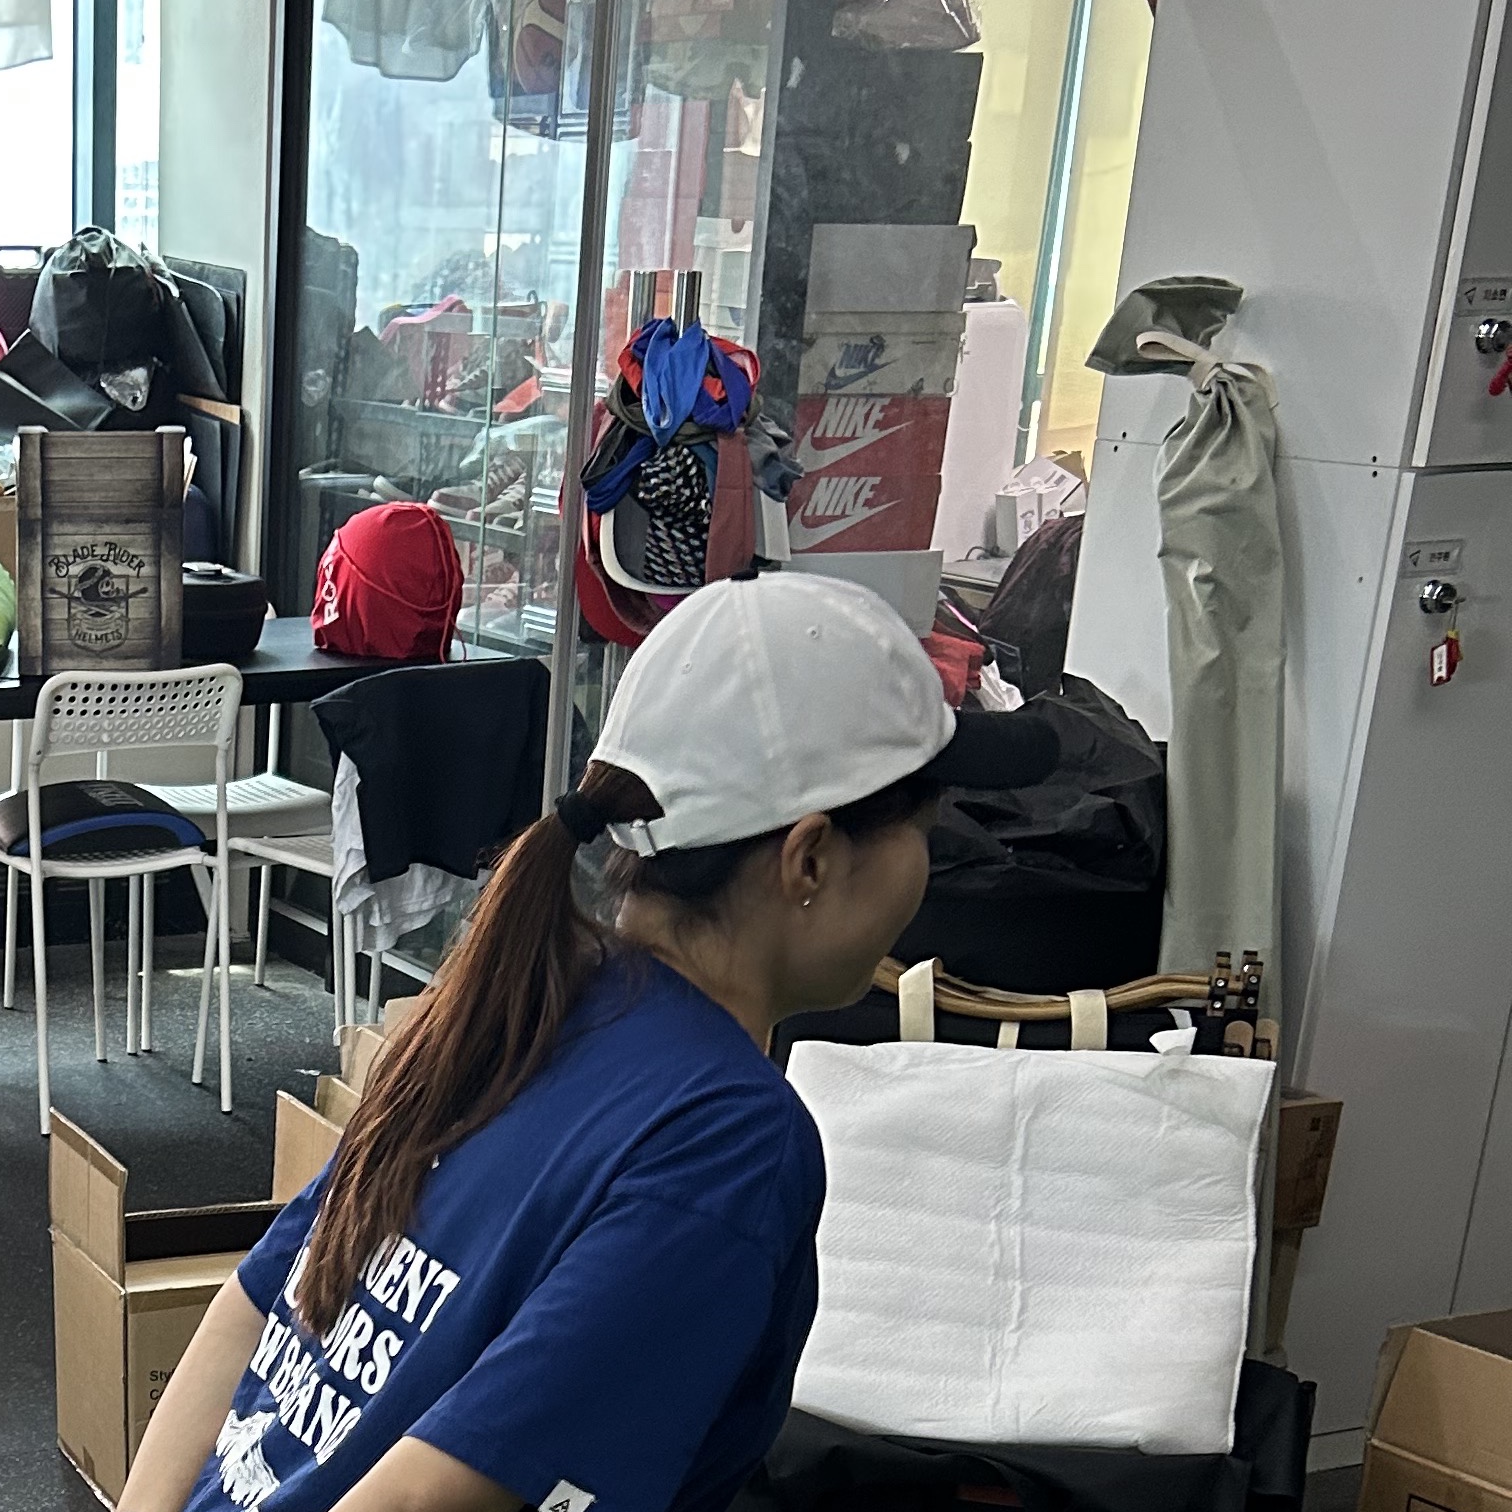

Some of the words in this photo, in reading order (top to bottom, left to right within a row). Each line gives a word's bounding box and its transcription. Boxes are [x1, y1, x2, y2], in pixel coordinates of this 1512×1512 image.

[814, 398, 892, 438] NIKE
[804, 477, 882, 516] NIKE
[48, 543, 98, 578] BLADE
[100, 541, 146, 579] RIDER
[73, 628, 123, 645] HELMETS
